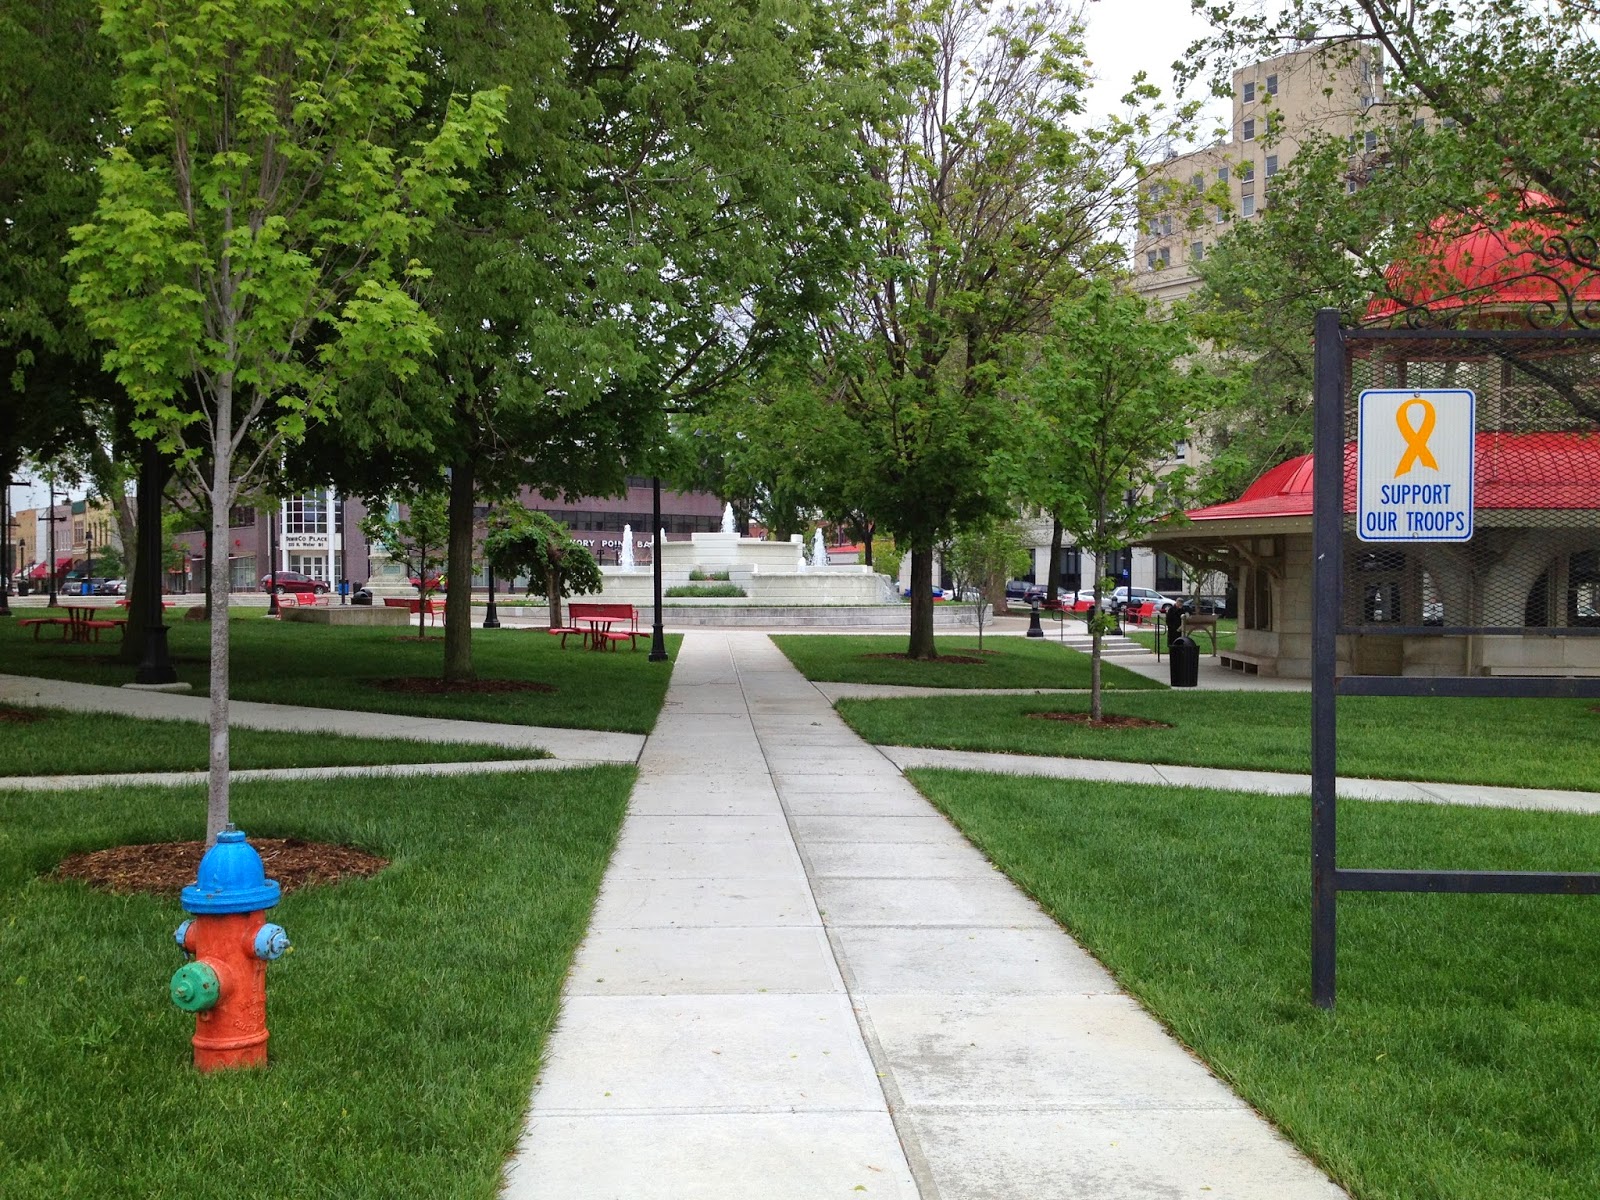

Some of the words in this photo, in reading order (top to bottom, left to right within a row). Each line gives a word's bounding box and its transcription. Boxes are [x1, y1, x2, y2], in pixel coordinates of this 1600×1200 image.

[1380, 484, 1451, 505] SUPPORT
[1366, 511, 1397, 532] OUR
[1406, 511, 1465, 532] TROOPS
